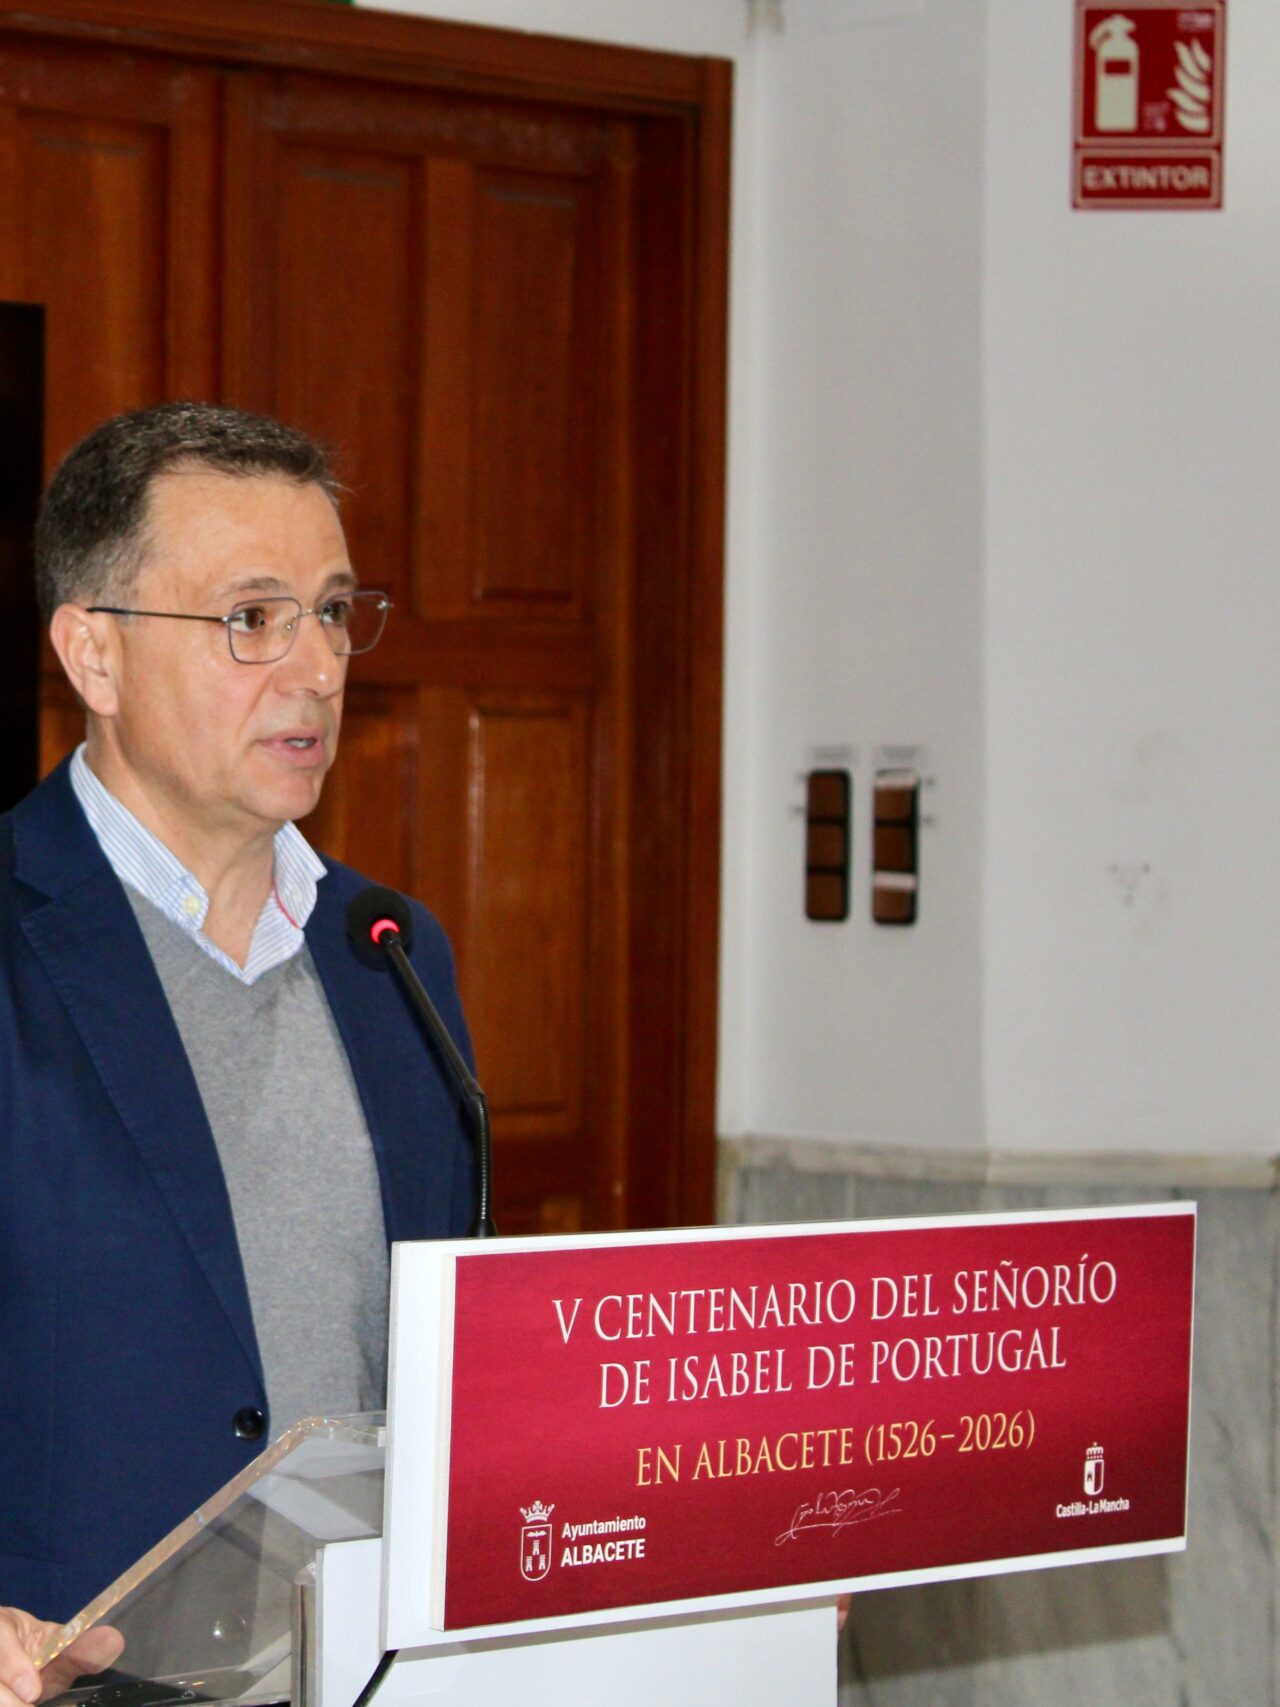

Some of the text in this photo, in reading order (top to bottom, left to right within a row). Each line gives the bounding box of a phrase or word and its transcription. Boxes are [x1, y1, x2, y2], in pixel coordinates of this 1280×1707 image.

[1083, 165, 1209, 190] EXTINTOR
[552, 1252, 1117, 1344] V CENTENARIO DEL SEÑORÍO
[598, 1326, 1068, 1409] DE ISABEL DE PORTUGAL
[636, 1444, 683, 1487] EN
[691, 1427, 854, 1481] ALBACETE
[560, 1514, 646, 1542] Ayuntamiento
[560, 1537, 646, 1568] ALBACETE
